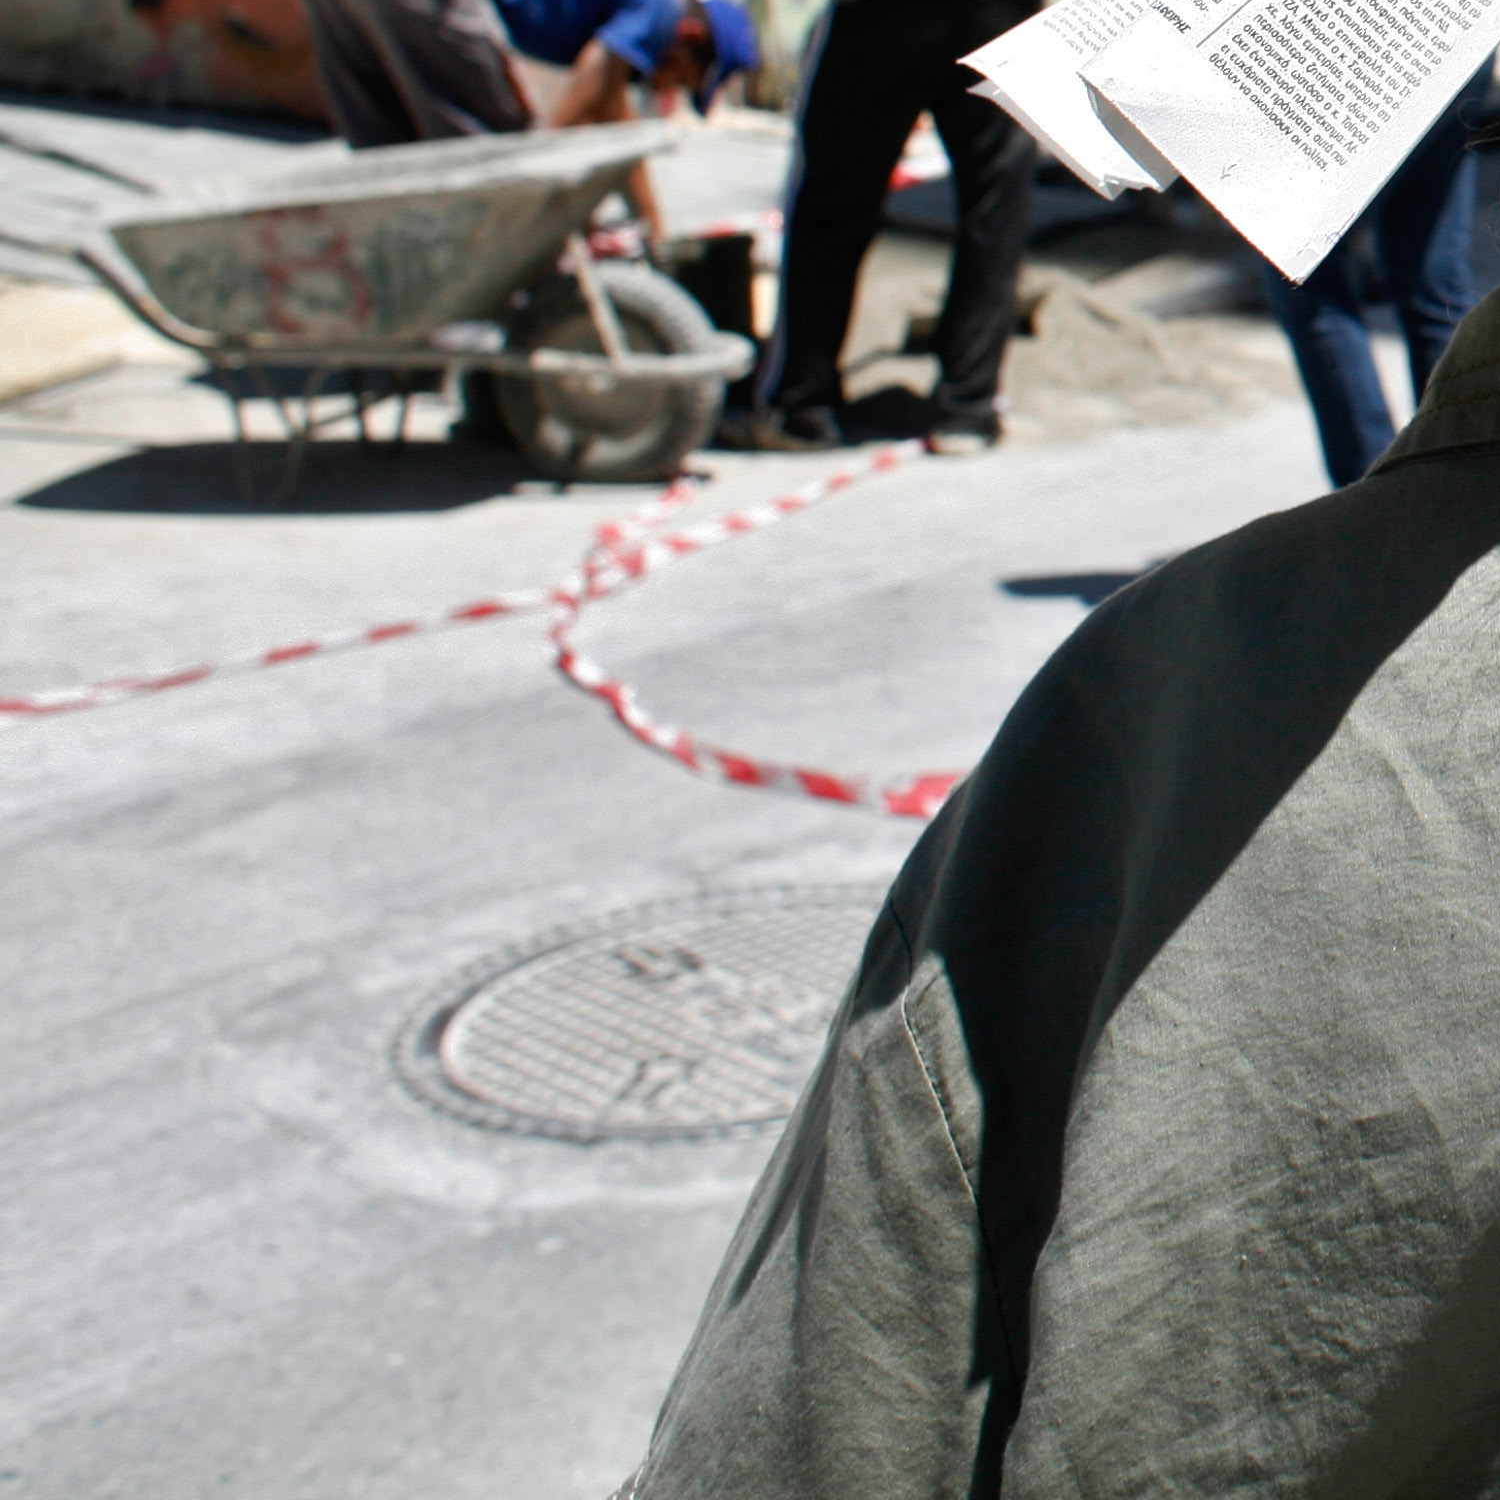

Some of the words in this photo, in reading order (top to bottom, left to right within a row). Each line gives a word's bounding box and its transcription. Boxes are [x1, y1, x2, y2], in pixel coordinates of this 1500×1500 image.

[1332, 5, 1383, 54] εντυπώσεις
[1379, 48, 1395, 65] θα
[1385, 37, 1403, 52] με
[1399, 47, 1412, 61] το
[1409, 38, 1426, 53] με
[1420, 5, 1438, 23] της
[1230, 32, 1252, 53] έχει
[1247, 48, 1267, 69] ένα
[1262, 64, 1299, 95] ισχυρό
[1251, 12, 1307, 66] περισσότερα
[1301, 60, 1346, 106] ζητήματα,
[1343, 100, 1369, 124] ιδίως
[1263, 1, 1279, 20] χε,
[1277, 13, 1304, 41] λόγω
[1300, 37, 1344, 83] εμπειρίας,
[1343, 78, 1381, 113] υπεροχή
[1297, 12, 1336, 48] Μπορεί
[1345, 58, 1384, 96] Σαμαράς
[1380, 91, 1394, 105] να
[1333, 27, 1386, 78] επικεφαλής
[1383, 73, 1401, 91] του
[1207, 51, 1242, 85] θέλουν
[1237, 80, 1252, 97] να
[1248, 93, 1295, 136] ακούσουν
[1289, 133, 1303, 146] οι
[1219, 42, 1231, 56] ει
[1228, 52, 1272, 95] ευχάριστα
[1268, 91, 1313, 138] πράγματα,
[1328, 149, 1349, 167] που
[1283, 68, 1325, 104] ωστόσο
[1339, 113, 1370, 145] Τσίπρας
